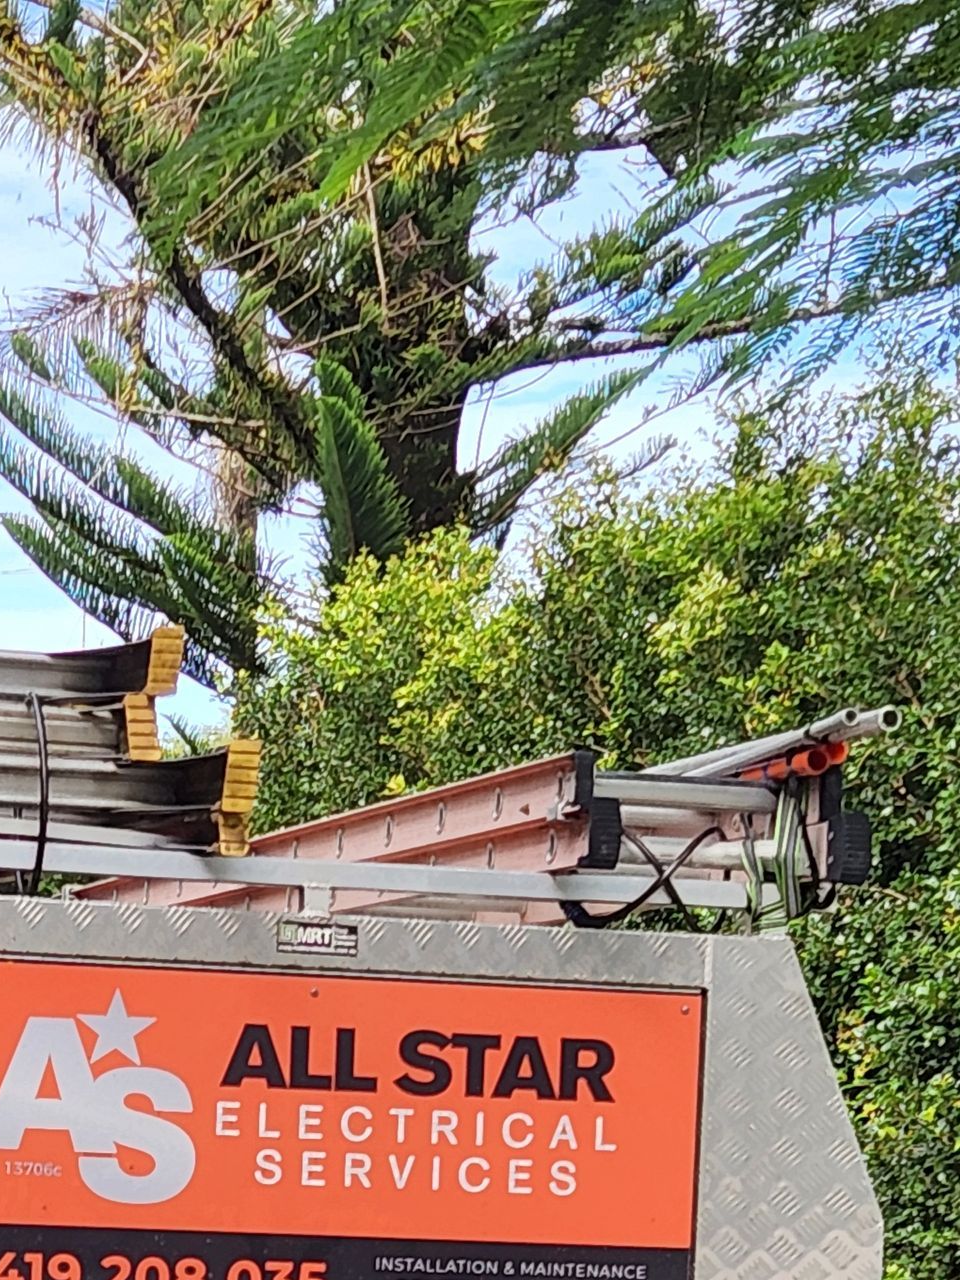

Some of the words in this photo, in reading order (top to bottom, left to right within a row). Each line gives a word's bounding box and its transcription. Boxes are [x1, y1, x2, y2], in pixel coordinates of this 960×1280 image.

[219, 1023, 378, 1093] ALL
[392, 1029, 616, 1103] STAR
[215, 1100, 617, 1152] ELECTRICAL
[254, 1149, 577, 1196] SERVICES
[375, 1256, 499, 1275] INSTALLATION
[503, 1260, 516, 1276] &
[520, 1261, 647, 1280] MAINTENANCE
